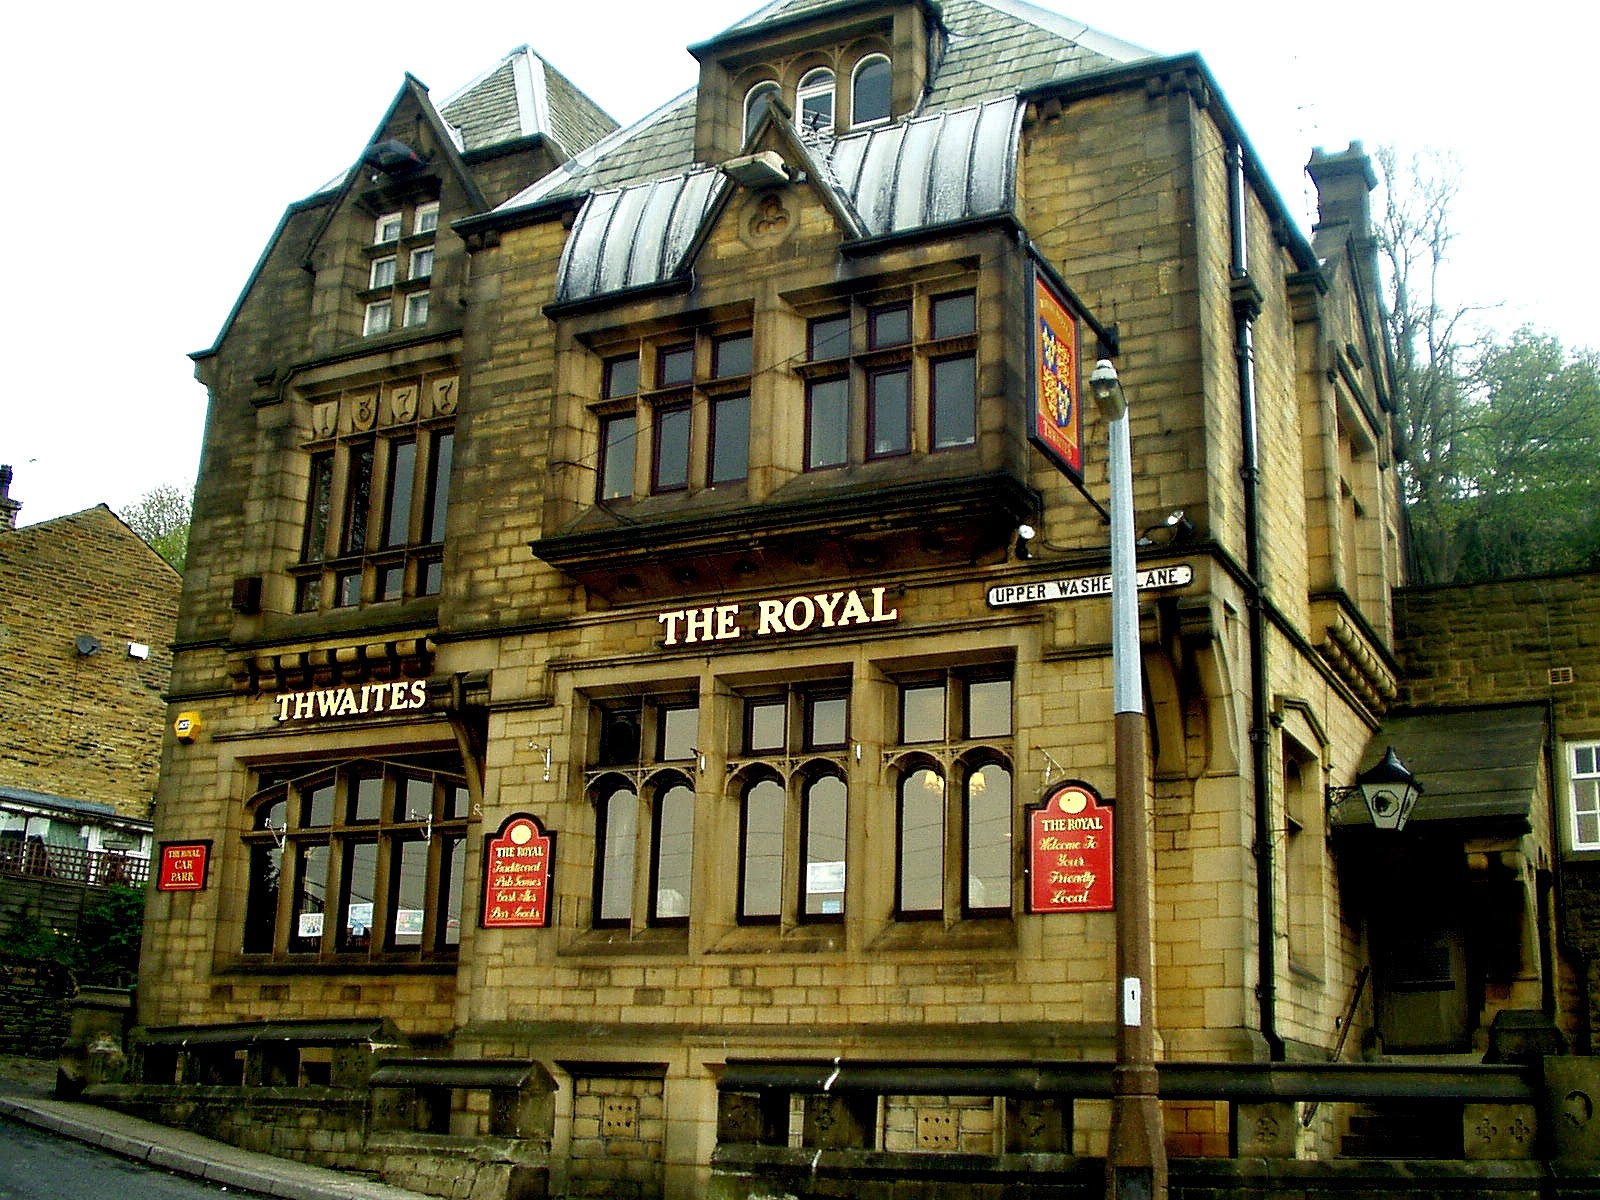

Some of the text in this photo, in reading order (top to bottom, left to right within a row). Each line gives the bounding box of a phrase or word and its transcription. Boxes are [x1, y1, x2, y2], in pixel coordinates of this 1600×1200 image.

[995, 584, 1047, 603] UPPER
[1057, 576, 1113, 596] WASHE
[658, 587, 898, 646] THE ROYAL
[275, 679, 427, 721] THWAITES
[1041, 817, 1104, 832] THE ROYAL
[1039, 836, 1081, 851] Welcome
[495, 846, 544, 858] THE ROYAL
[174, 860, 193, 870] CAR
[1056, 853, 1085, 867] Your
[171, 872, 194, 882] PARK
[1049, 871, 1096, 888] Friendly
[1050, 890, 1089, 904] Local
